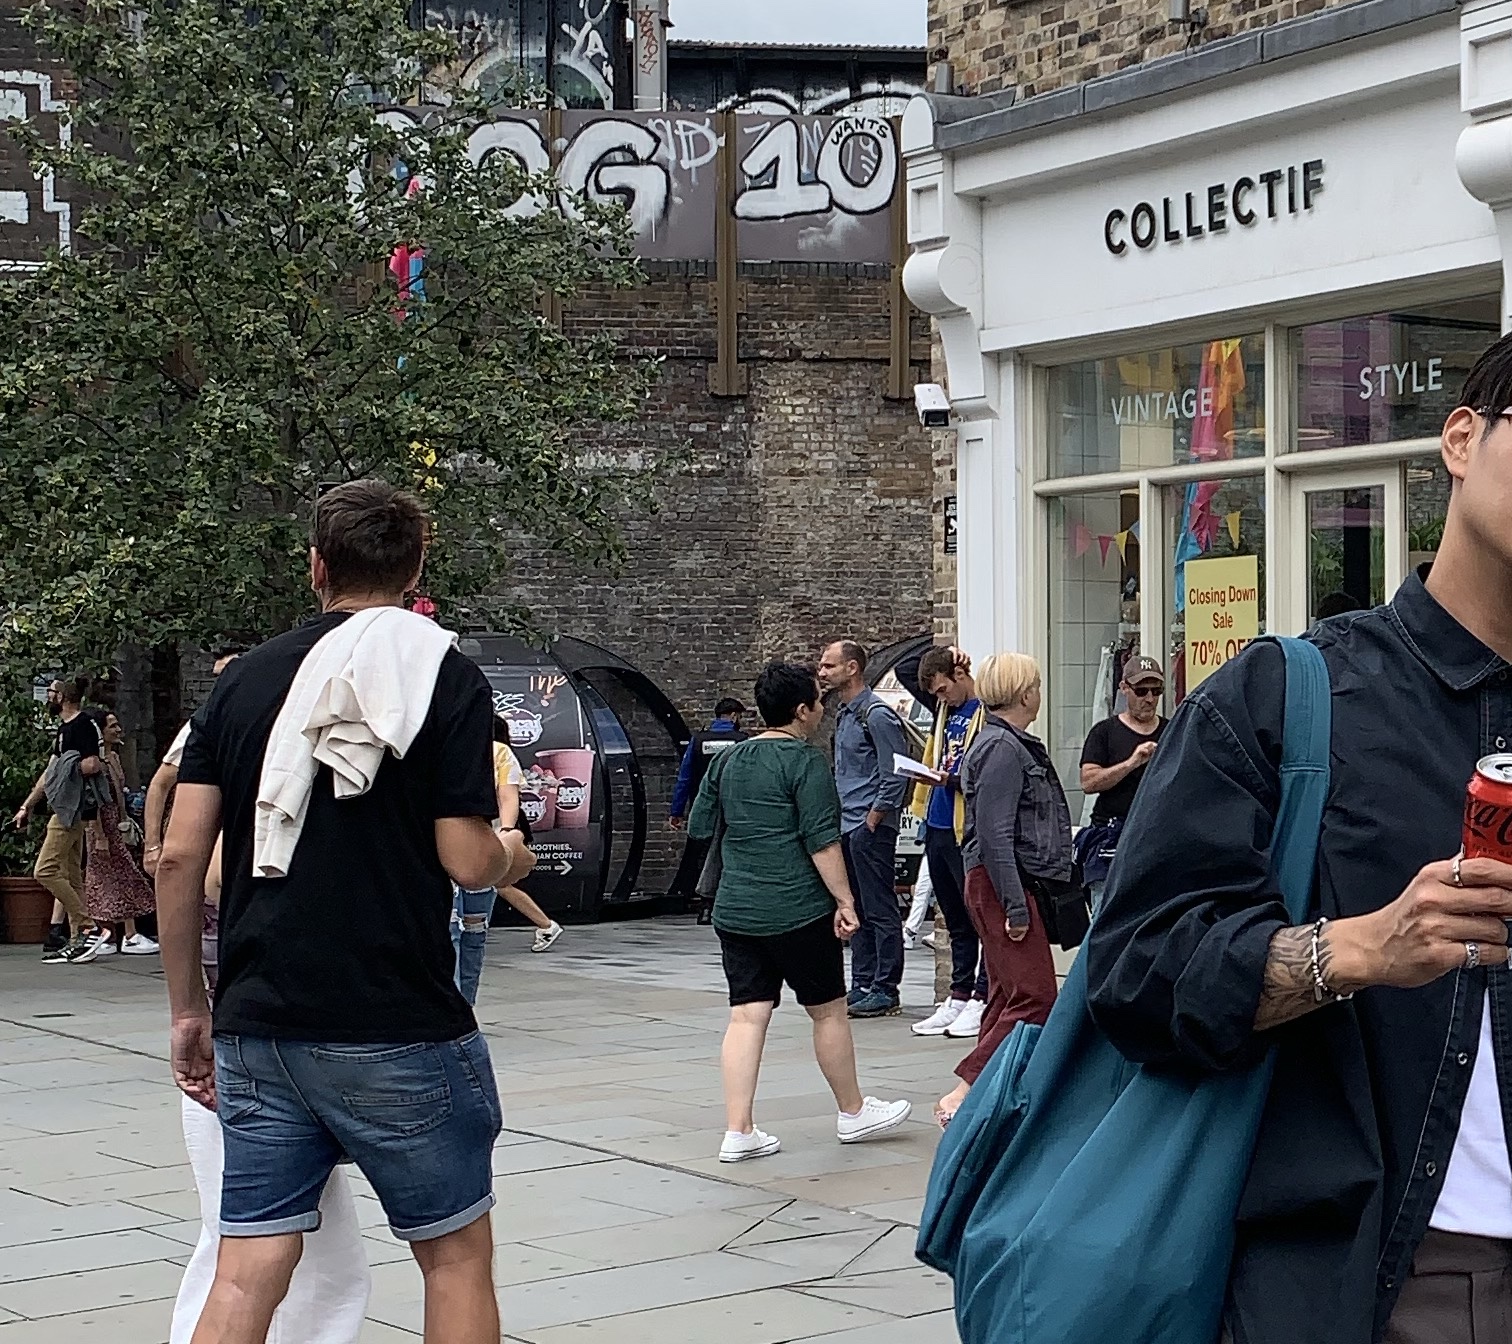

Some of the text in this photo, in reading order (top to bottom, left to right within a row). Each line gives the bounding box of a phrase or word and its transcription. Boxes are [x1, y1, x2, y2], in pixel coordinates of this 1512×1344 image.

[831, 118, 888, 145] WANTS
[735, 117, 897, 222] 10
[1105, 159, 1324, 255] COLLECTIF
[1359, 357, 1443, 400] STYLE
[1111, 387, 1213, 425] VINTAGE
[1189, 585, 1256, 607] Closing Down
[1212, 611, 1233, 629] Sale
[1191, 638, 1254, 667] 70% OF
